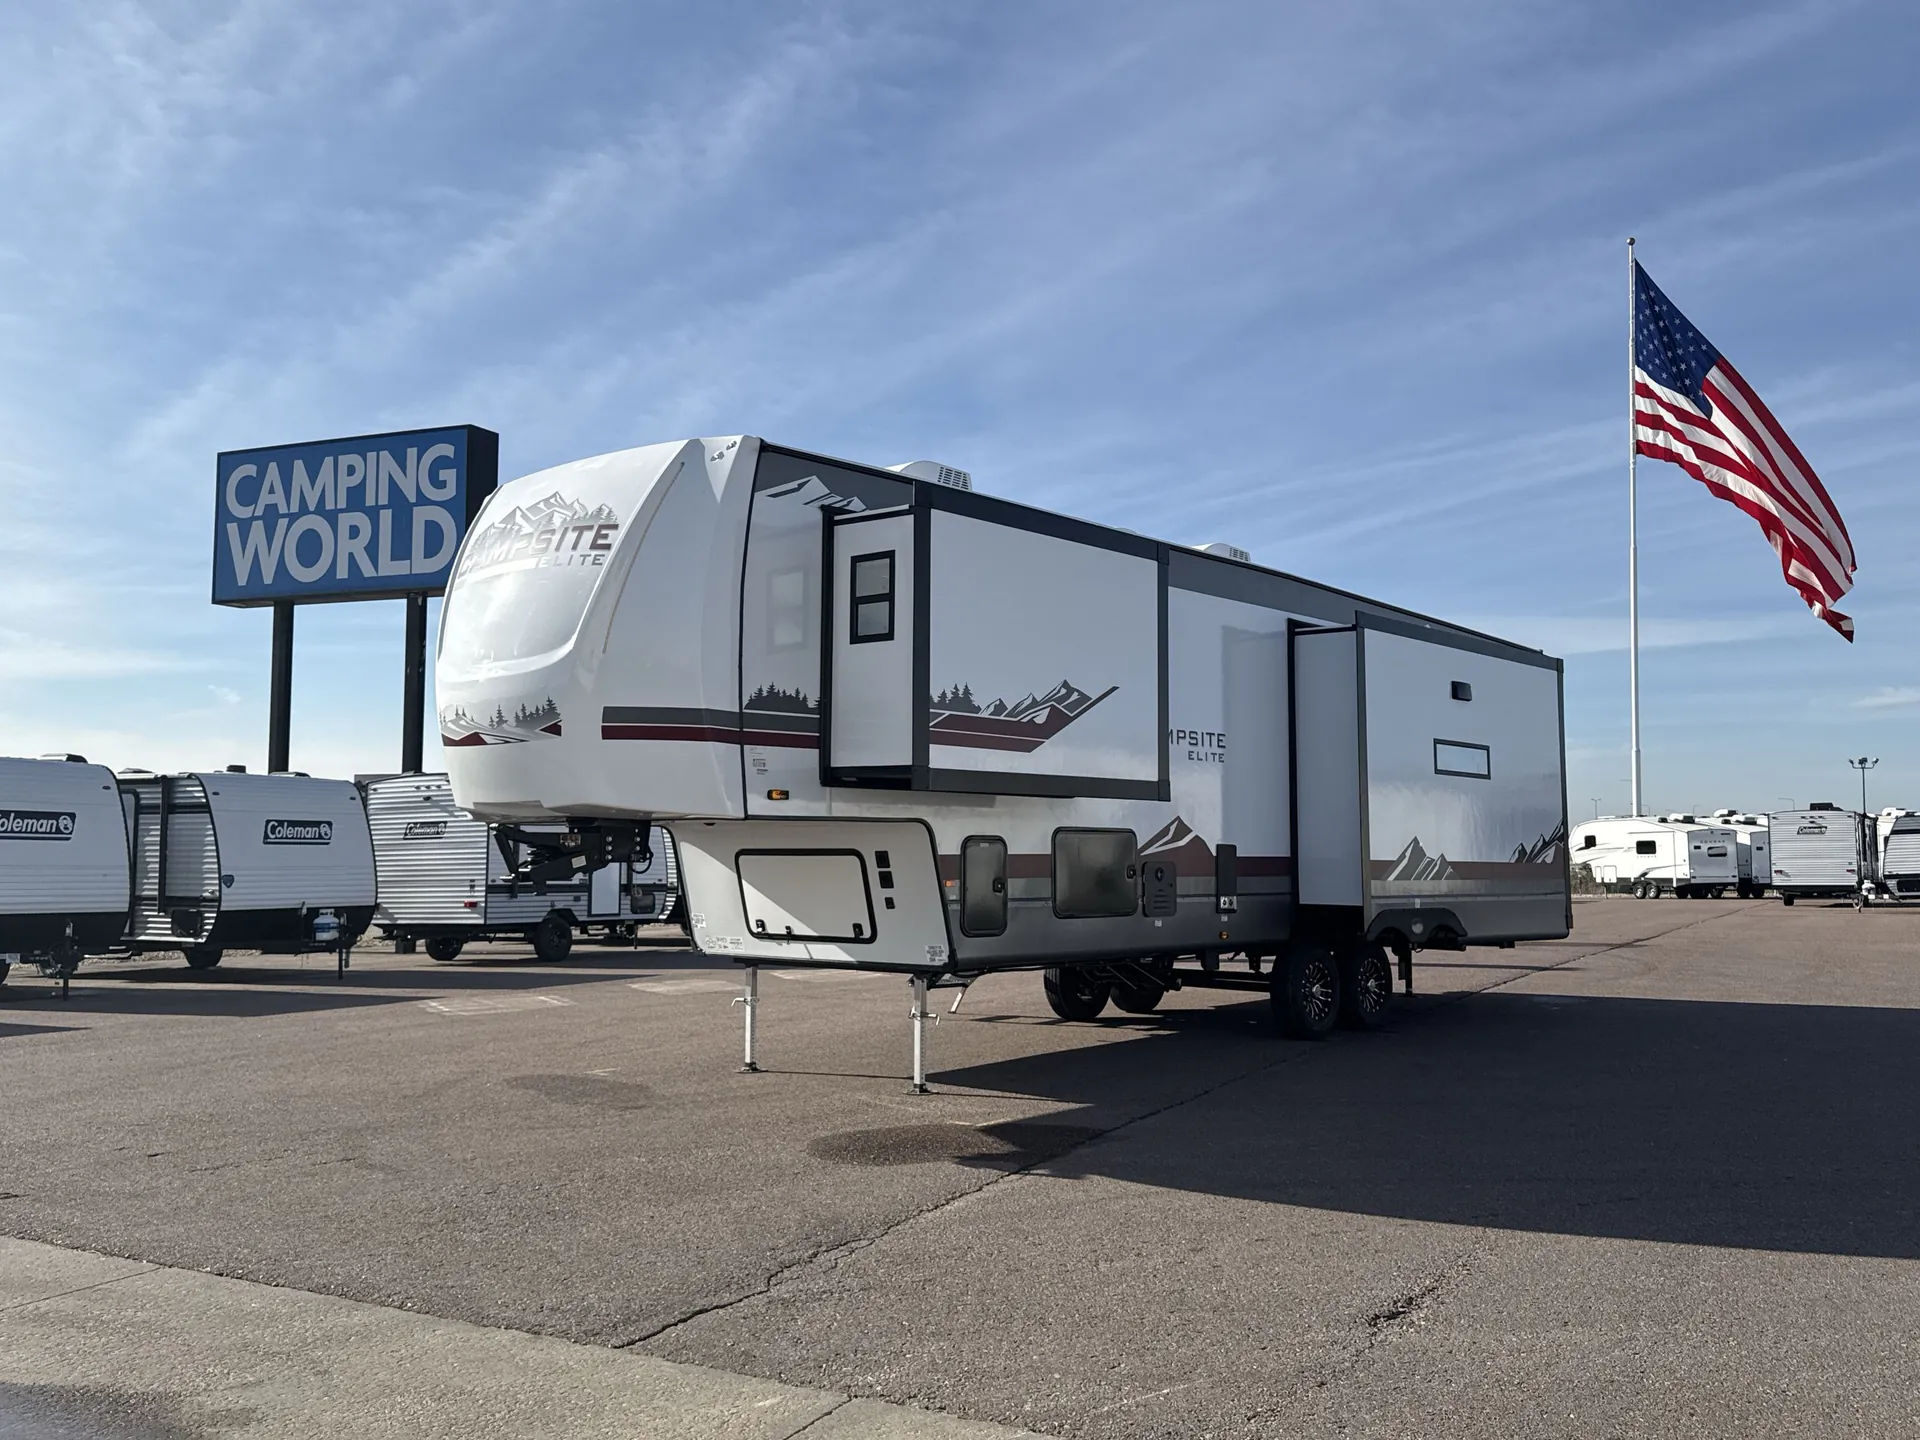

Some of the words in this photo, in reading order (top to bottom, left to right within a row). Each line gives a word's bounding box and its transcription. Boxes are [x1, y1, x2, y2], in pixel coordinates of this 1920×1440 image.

[226, 443, 457, 518] CAMPING
[226, 505, 457, 586] WORLD
[539, 553, 605, 568] ELITE
[1188, 750, 1225, 763] ELITE
[0, 812, 57, 832] oleman
[267, 821, 319, 839] Coleman
